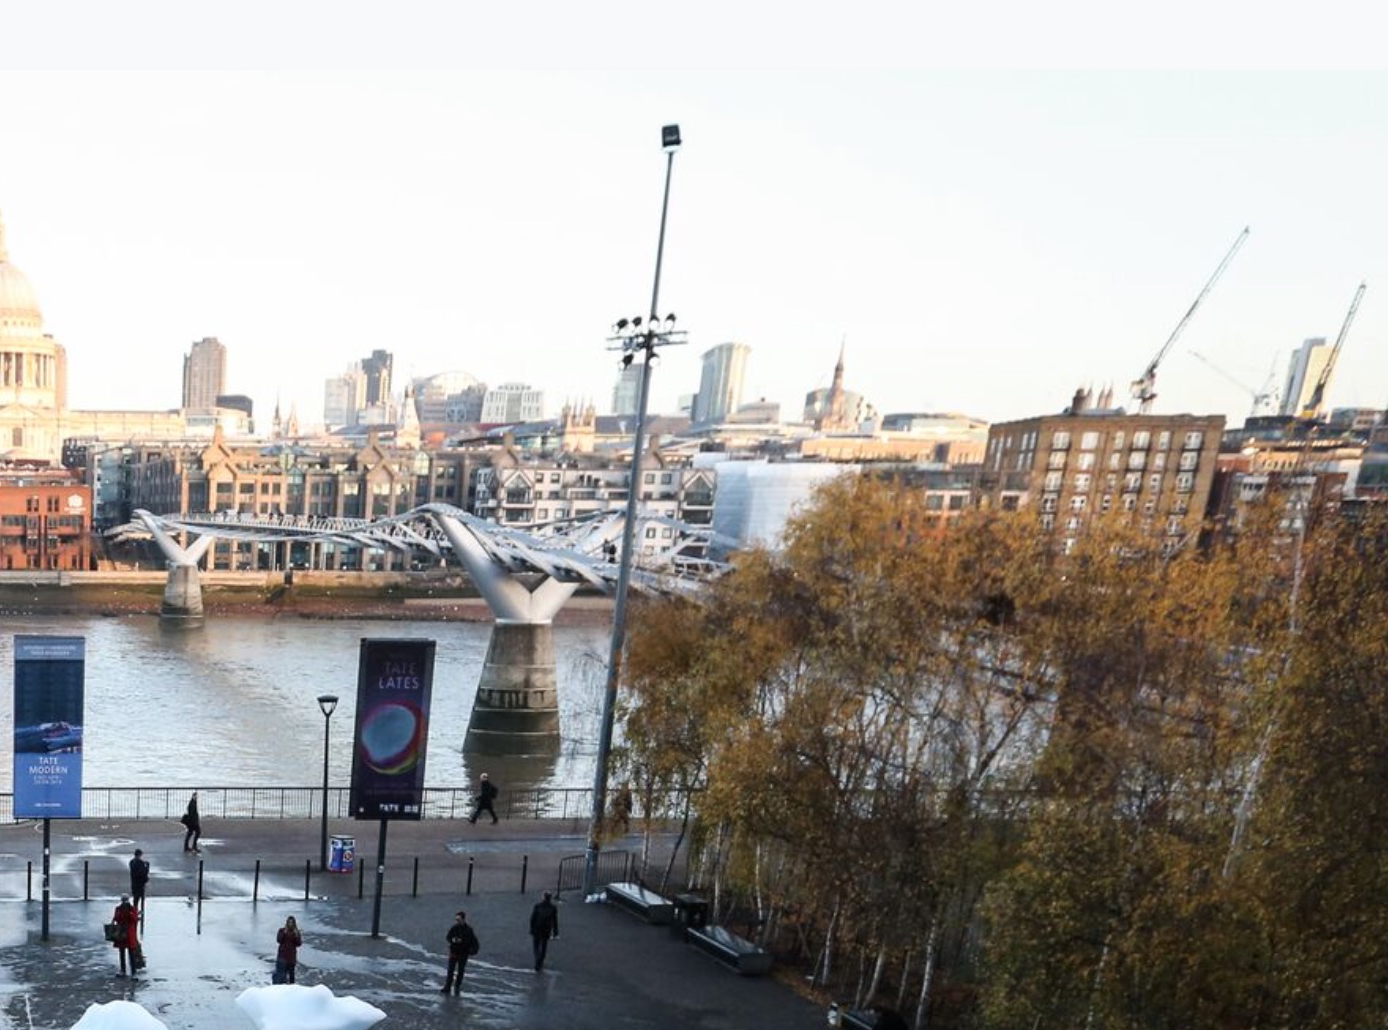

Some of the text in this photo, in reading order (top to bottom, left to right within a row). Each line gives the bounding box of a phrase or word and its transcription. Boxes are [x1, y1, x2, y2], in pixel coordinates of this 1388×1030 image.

[383, 662, 418, 675] TATE
[378, 676, 420, 689] LATES
[39, 756, 59, 765] TATE
[28, 765, 69, 775] MODERN
